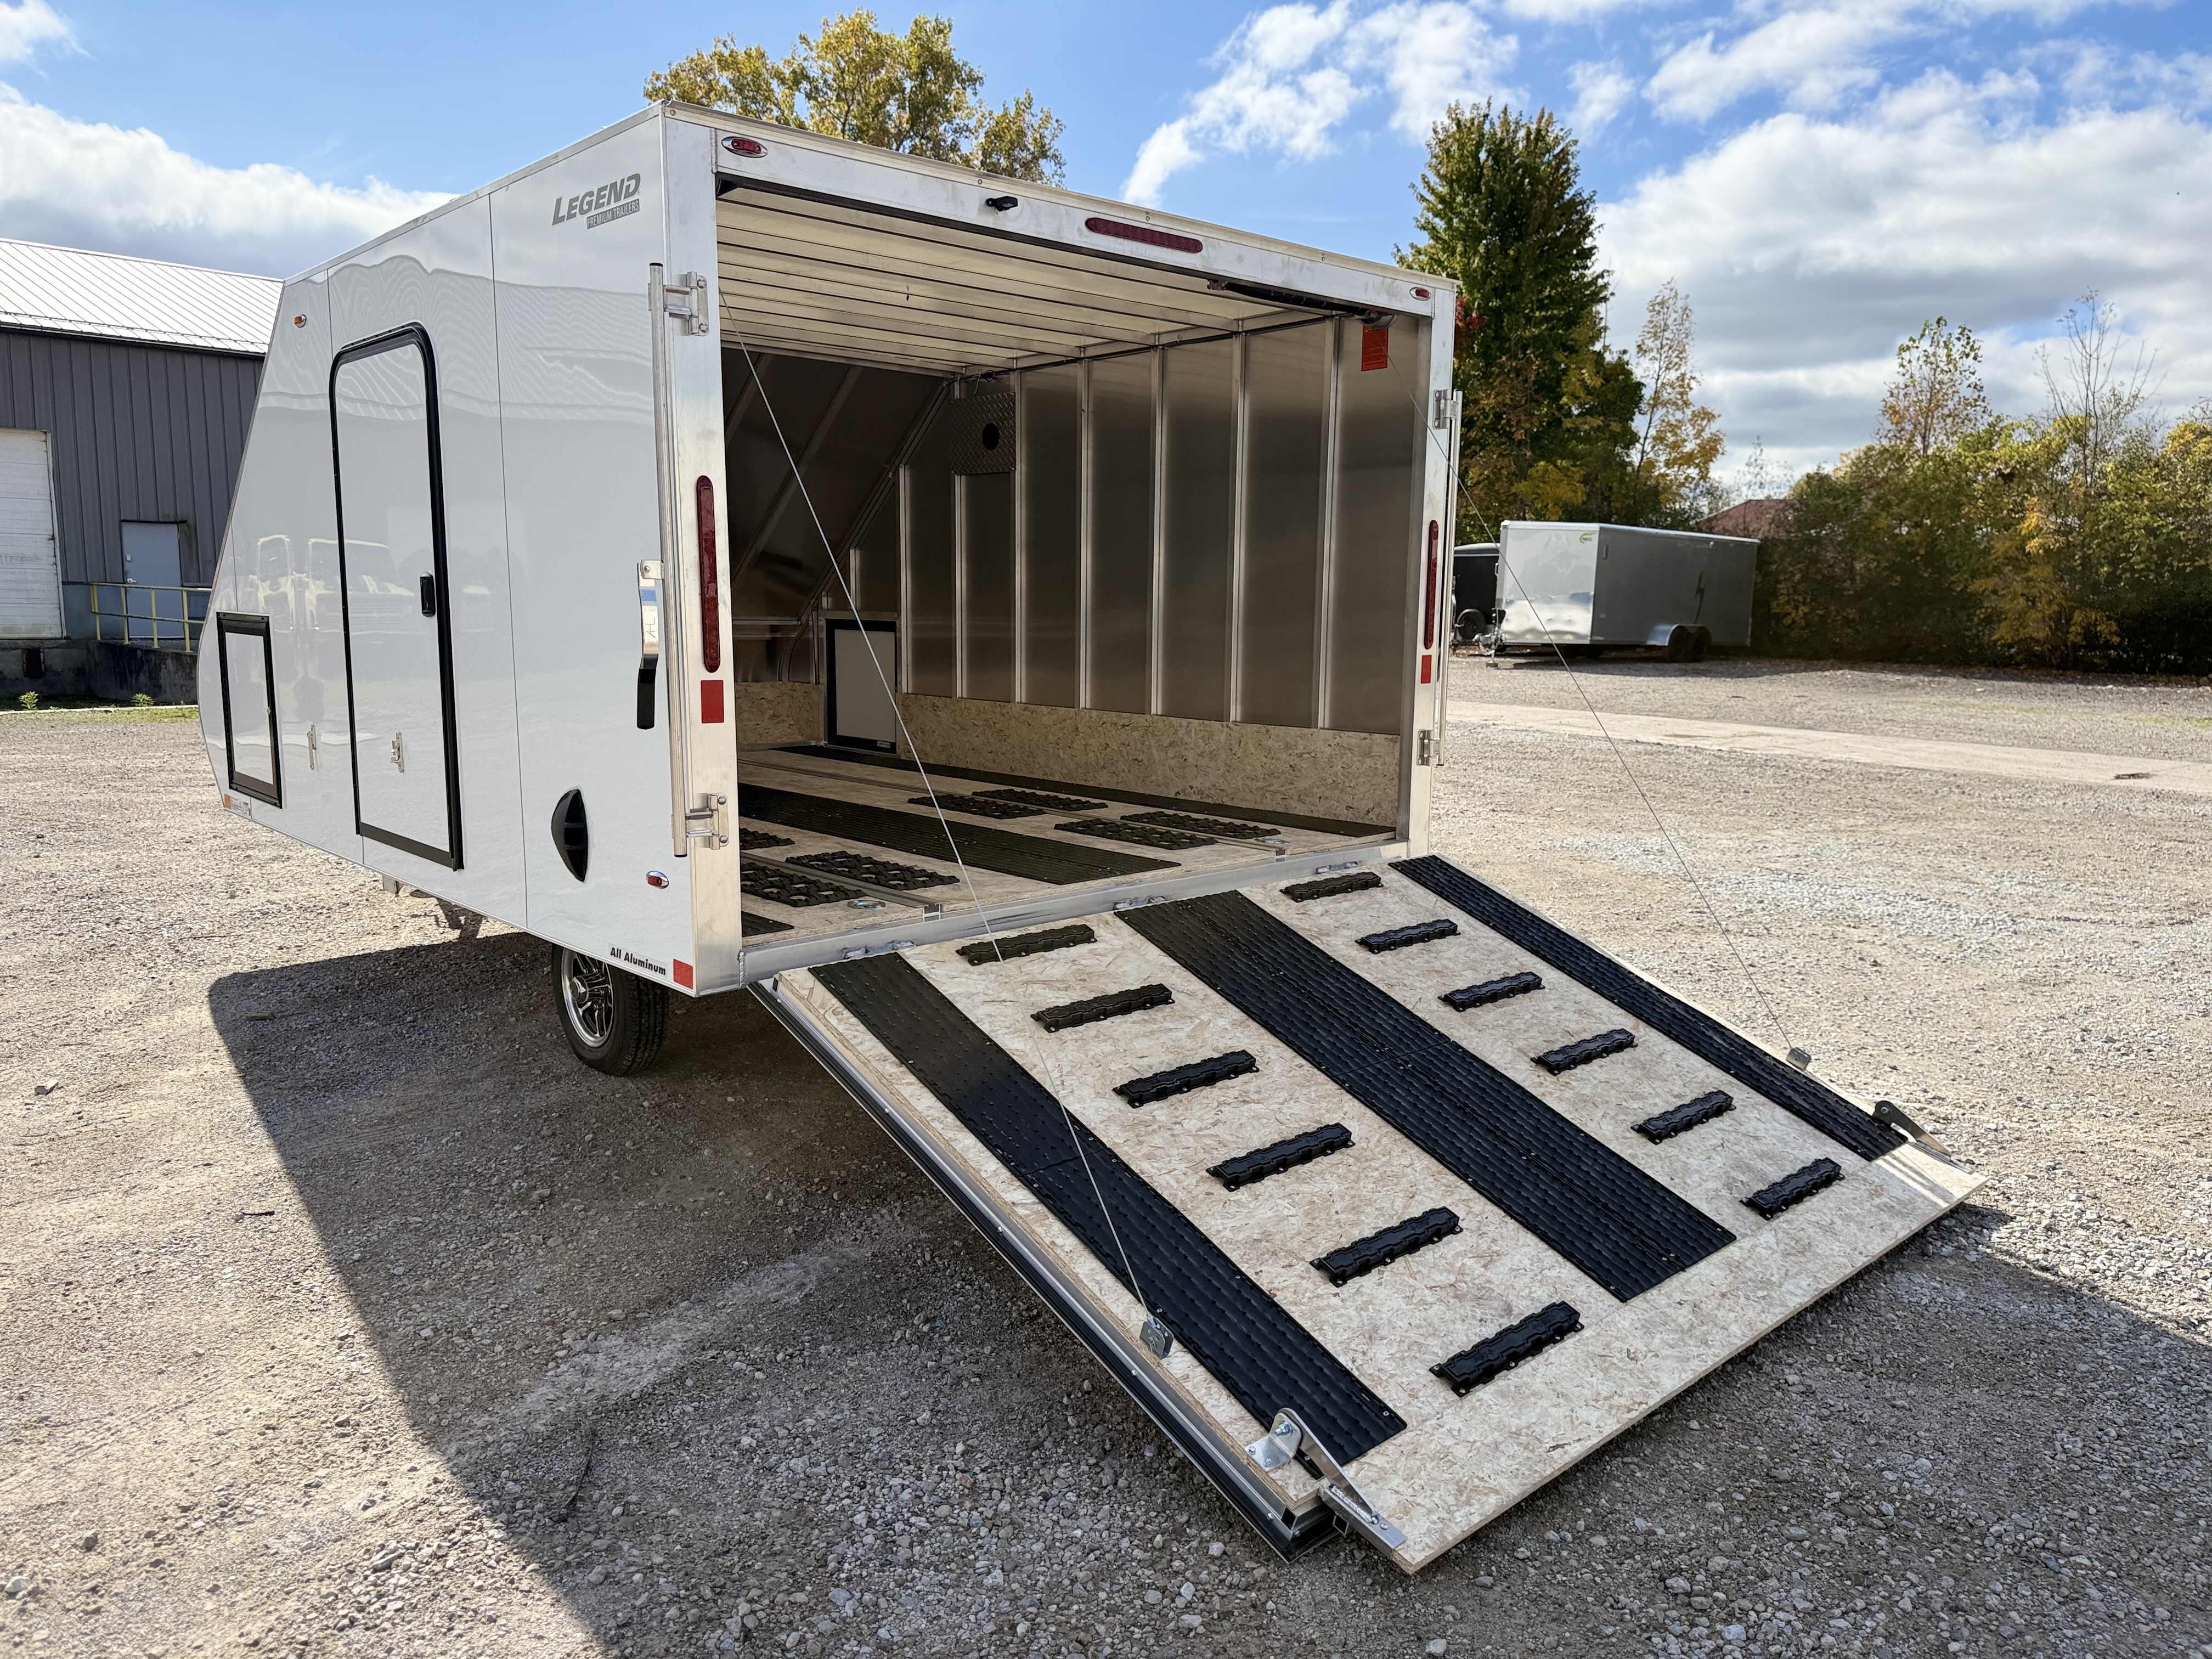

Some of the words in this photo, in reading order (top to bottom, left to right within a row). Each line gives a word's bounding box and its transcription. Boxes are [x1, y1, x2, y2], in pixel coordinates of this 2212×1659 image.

[552, 173, 641, 225] LEGEND
[586, 212, 612, 228] PREMIUM
[613, 200, 640, 218] TRAILERS
[610, 947, 622, 959] All
[624, 952, 666, 975] Aluminum
